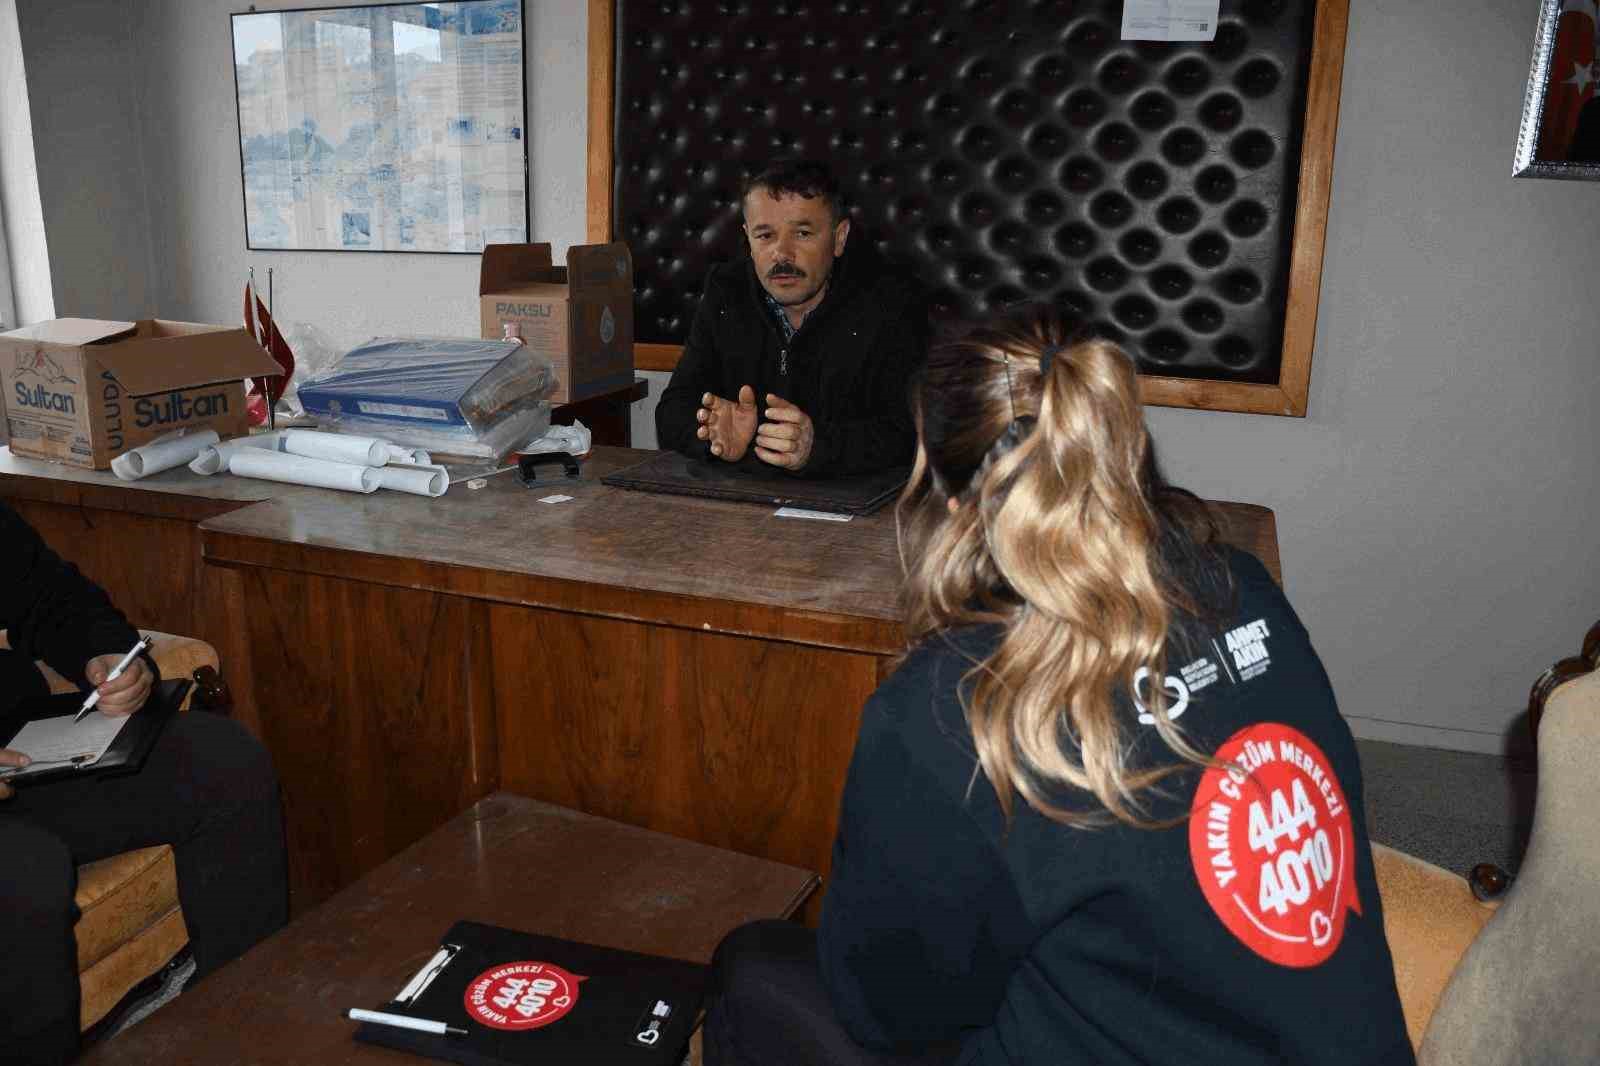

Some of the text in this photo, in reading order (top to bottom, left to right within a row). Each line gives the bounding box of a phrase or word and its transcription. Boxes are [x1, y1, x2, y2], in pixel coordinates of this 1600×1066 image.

[496, 302, 553, 318] PAKSU
[15, 380, 76, 414] Sultan
[134, 389, 229, 428] Sultan
[1207, 802, 1237, 888] YAKIN
[1279, 740, 1344, 818] MERKEZİ
[1248, 778, 1317, 855] 444
[1259, 828, 1333, 916] 4010
[492, 978, 530, 1009] 444
[515, 978, 557, 1017] 4010
